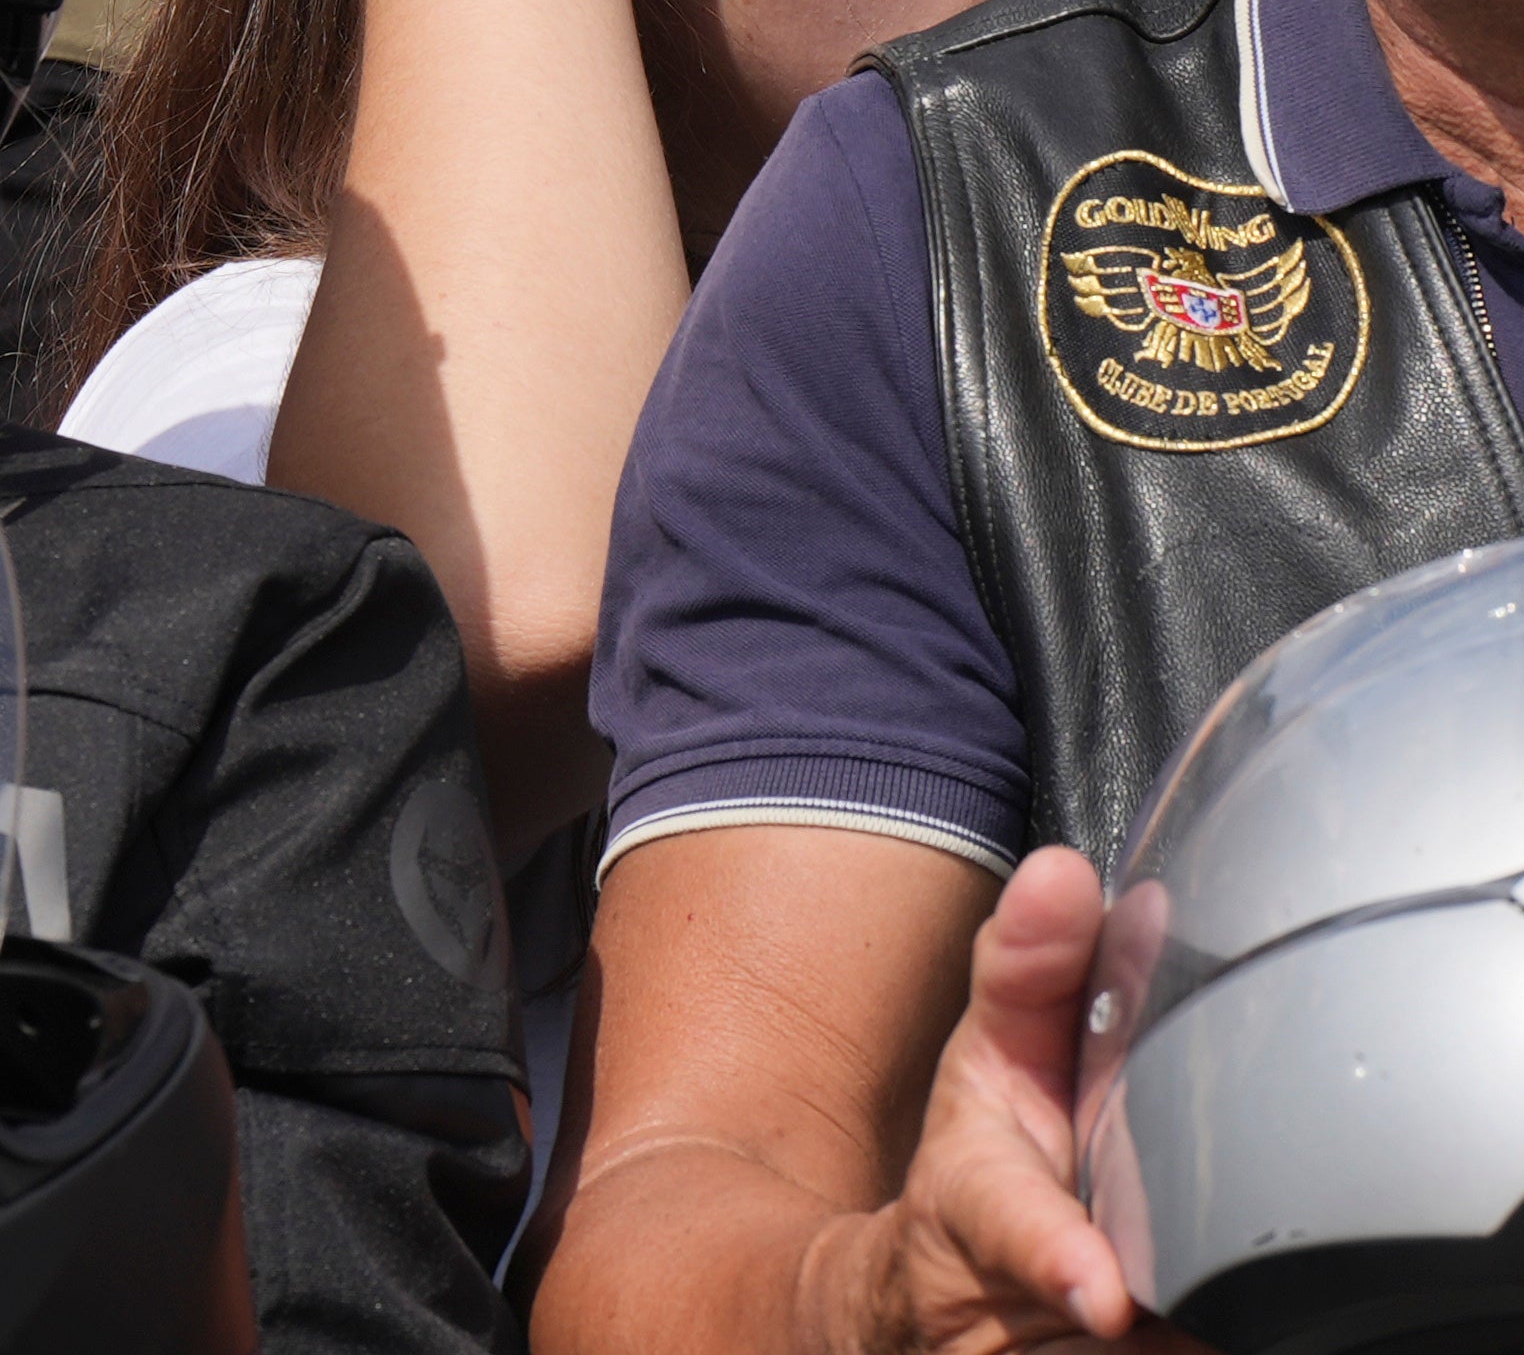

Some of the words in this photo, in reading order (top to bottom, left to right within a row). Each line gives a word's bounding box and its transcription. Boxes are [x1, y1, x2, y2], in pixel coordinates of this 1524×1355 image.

[1097, 357, 1173, 414] CLUBE
[1172, 389, 1220, 416] DE
[1222, 341, 1335, 415] PORTUGAL
